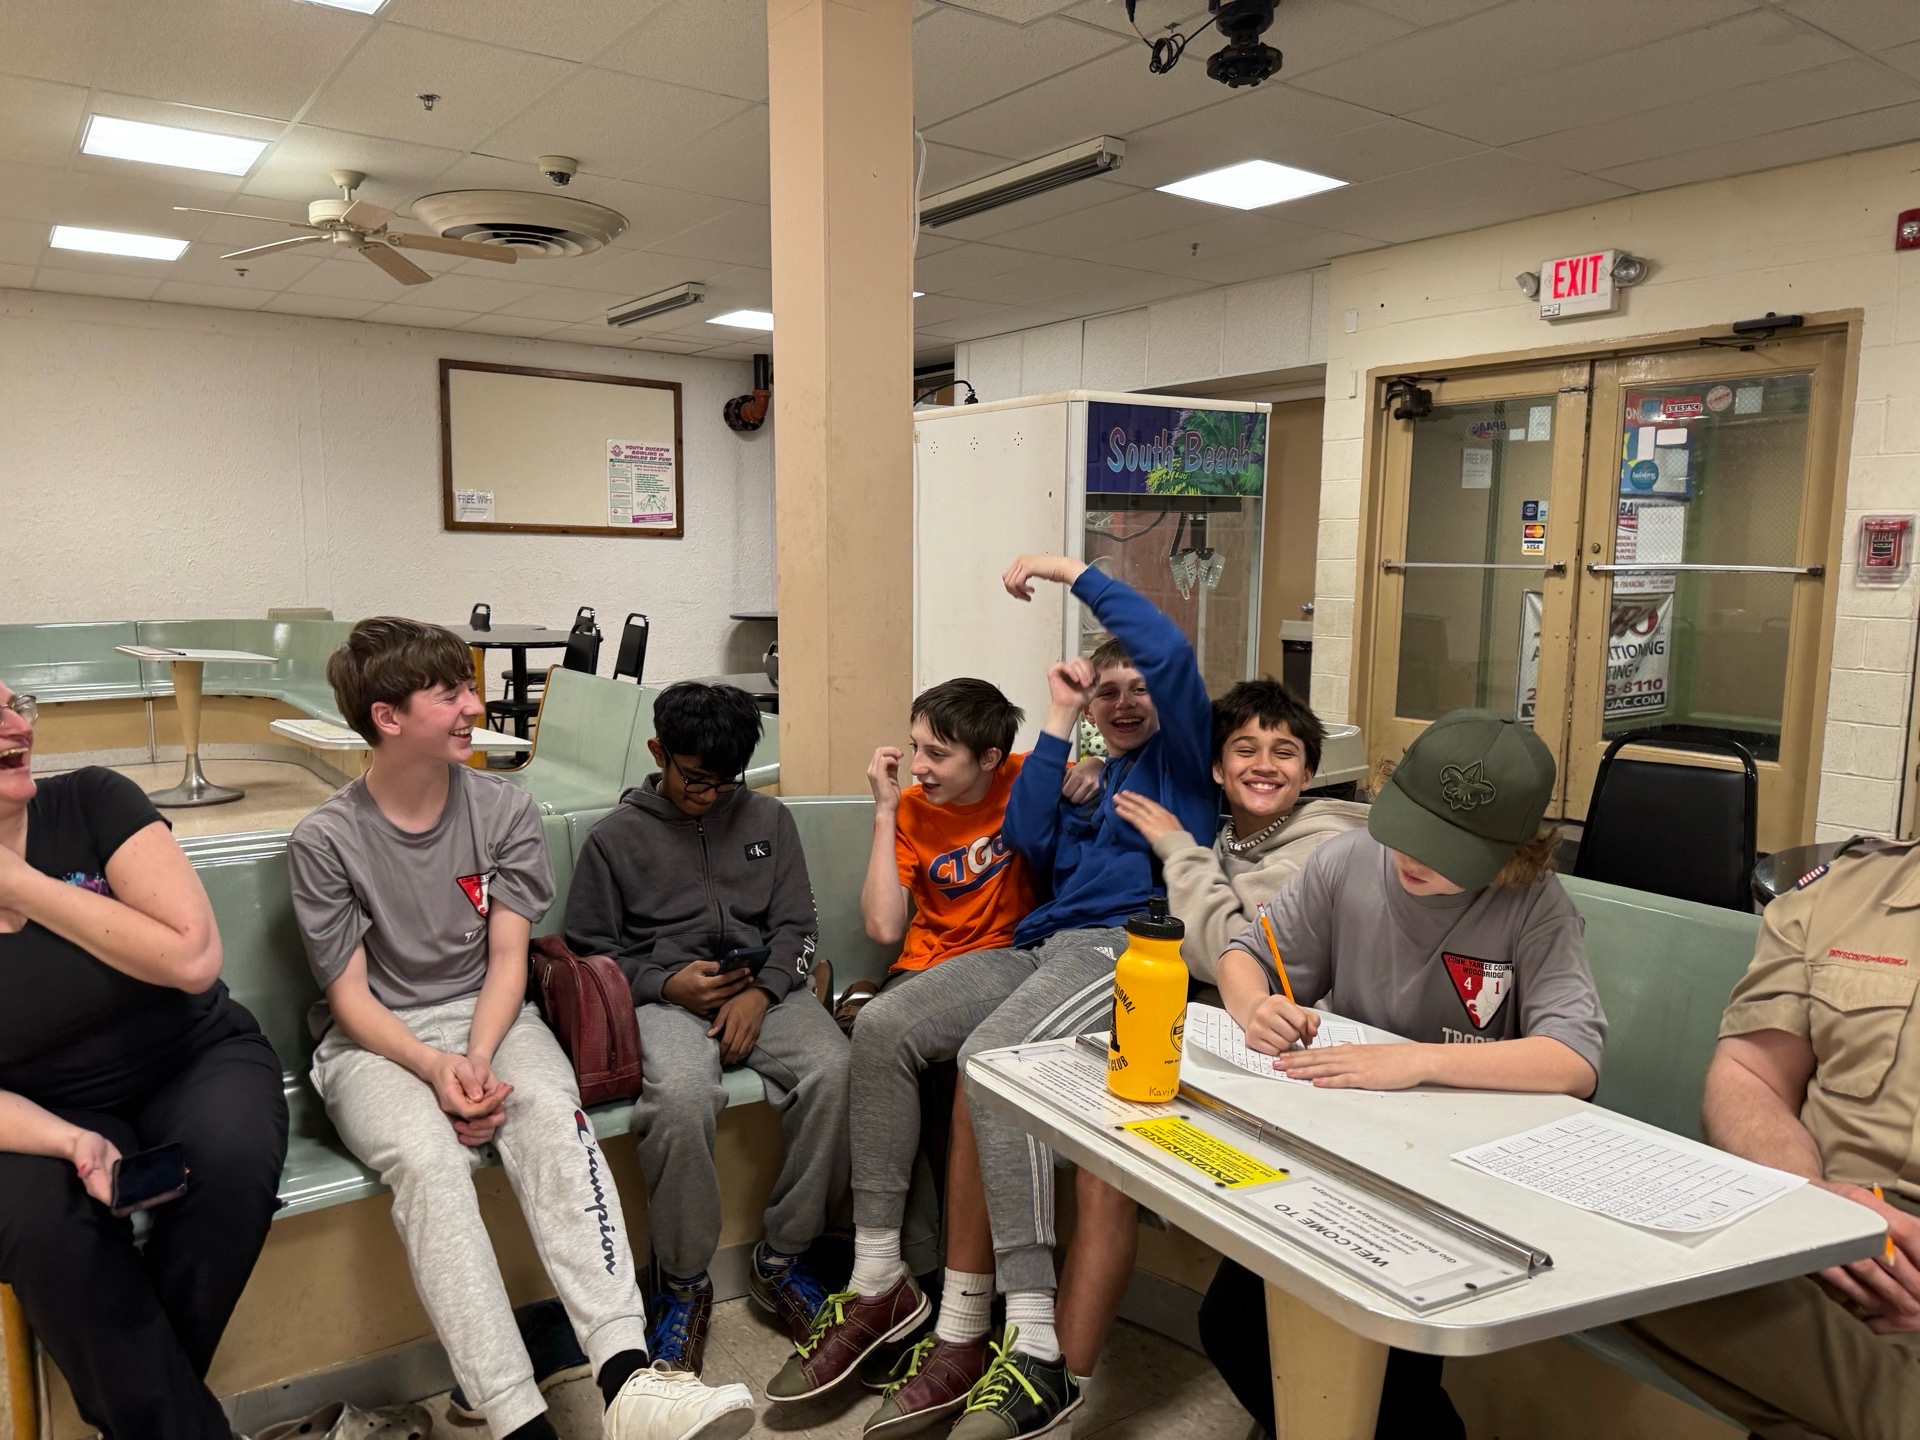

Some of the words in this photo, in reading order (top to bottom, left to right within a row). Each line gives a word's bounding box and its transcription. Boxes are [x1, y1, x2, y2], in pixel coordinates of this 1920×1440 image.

[1553, 254, 1604, 299] EXIT
[1106, 426, 1174, 473] South
[1184, 430, 1250, 475] Beach
[458, 494, 476, 504] FREE
[1872, 532, 1895, 540] FIRE
[1448, 956, 1467, 965] CONN.
[1469, 960, 1492, 970] YANKEE
[1462, 967, 1504, 978] WOODBRIDGE
[1464, 977, 1472, 990] 4
[1495, 981, 1500, 994] 1
[1111, 1055, 1129, 1072] CLUB
[1135, 1128, 1220, 1174] WARNING
[574, 1109, 616, 1275] Champion
[1309, 1186, 1347, 1205] Sundays
[1271, 1202, 1301, 1217] TO
[1353, 1209, 1401, 1233] Saturdays
[1296, 1217, 1390, 1267] WELCOME
[1411, 1240, 1439, 1253] Bowl
[1436, 1253, 1458, 1263] Glo
